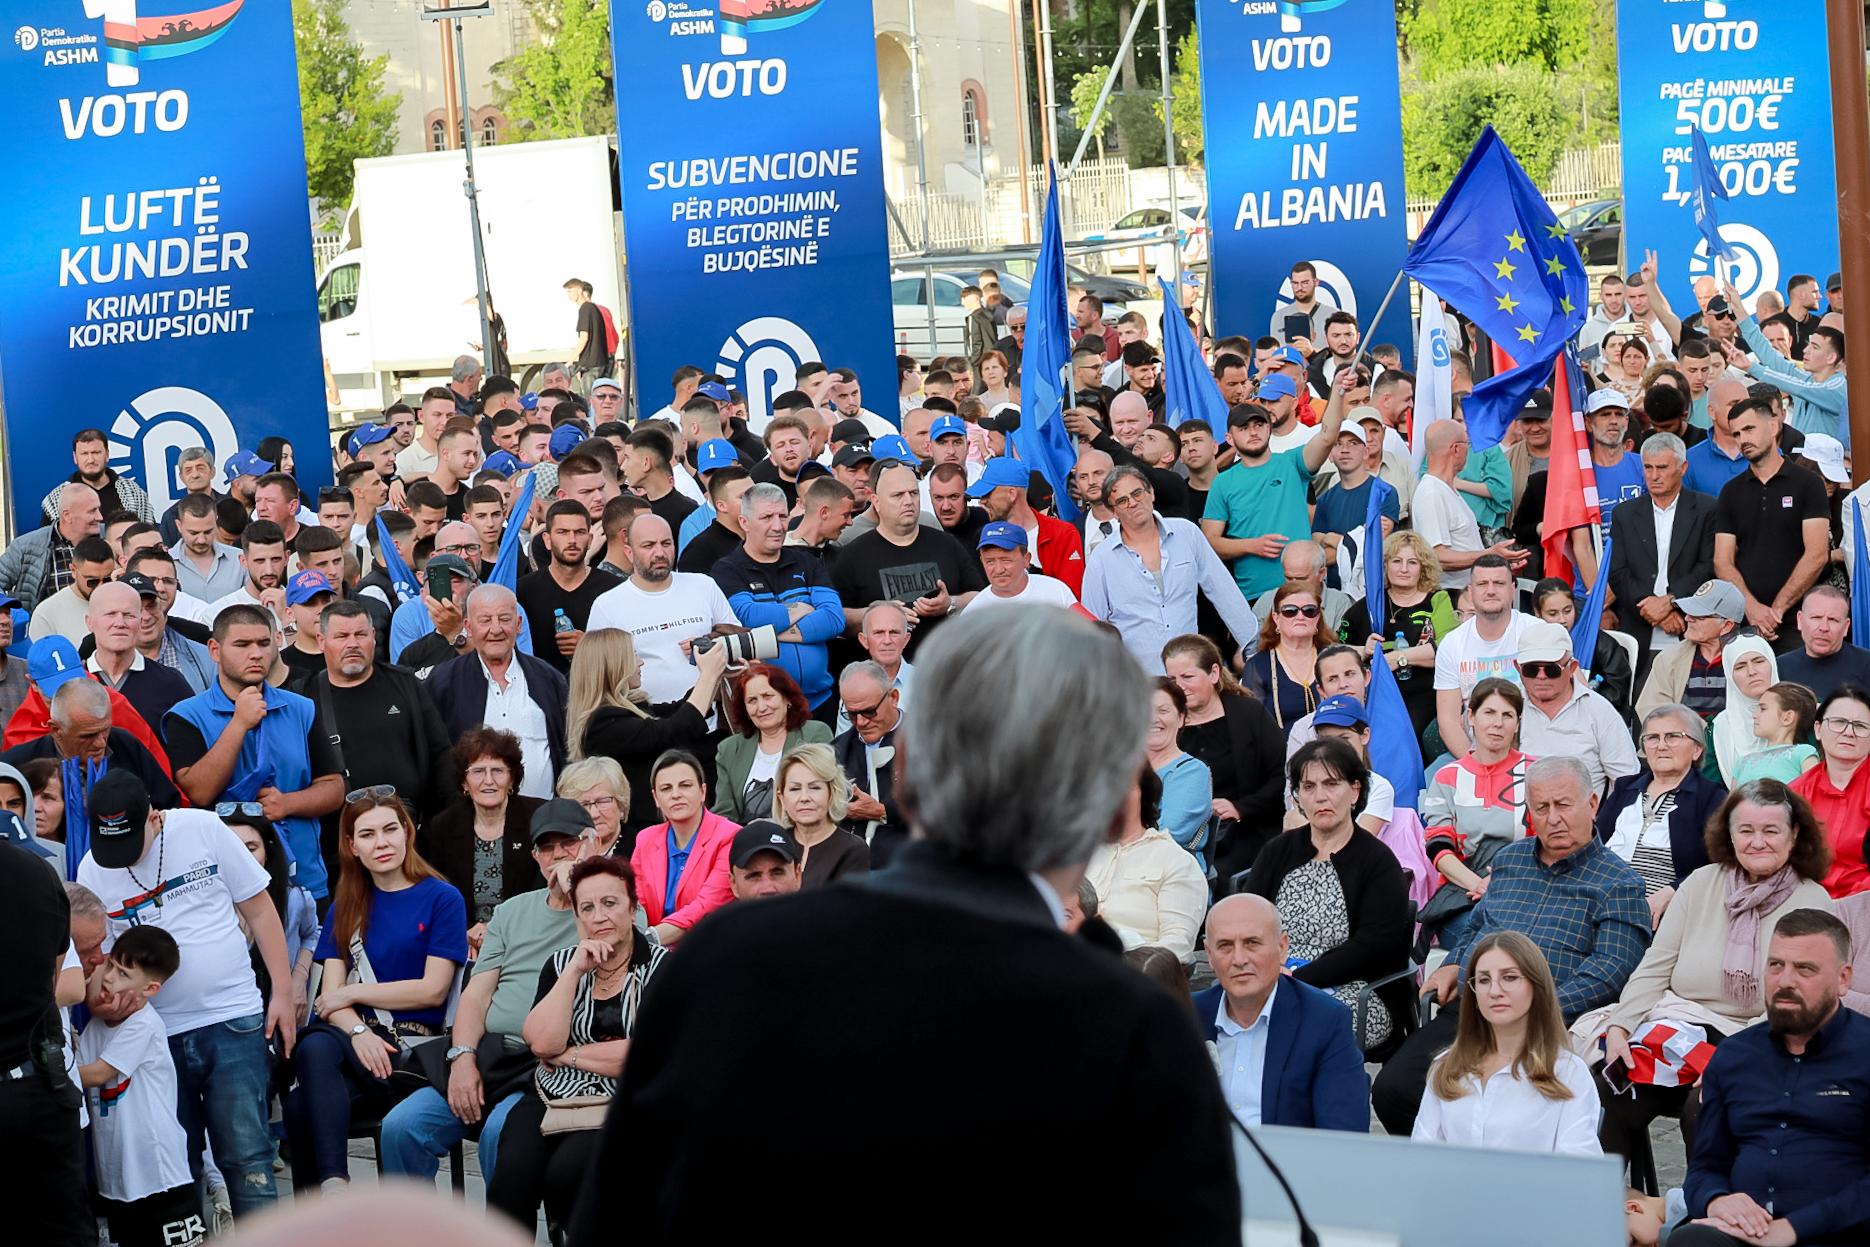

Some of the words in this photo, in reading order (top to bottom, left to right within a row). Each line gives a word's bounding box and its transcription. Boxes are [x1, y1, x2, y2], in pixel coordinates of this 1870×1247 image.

[668, 3, 688, 11] Partia
[669, 9, 714, 19] Demokratike
[1243, 2, 1277, 15] ASHM
[41, 28, 65, 37] Partia
[42, 35, 97, 46] Demokratike
[670, 20, 715, 36] ASHM
[1671, 20, 1759, 54] VOTO
[44, 47, 98, 66] ASHM
[1251, 35, 1331, 72] VOTO
[681, 58, 787, 100] VOTO
[1659, 78, 1704, 99] PAGË
[1706, 76, 1795, 98] MINIMALE
[59, 89, 189, 140] VOTO
[1253, 95, 1359, 139] MADE
[1674, 94, 1783, 136] 500€
[1291, 141, 1327, 181] IN
[1709, 141, 1797, 162] MESATARE
[647, 148, 859, 190] SUBVENCIONE
[1661, 158, 1799, 208] 1,00€
[79, 176, 221, 235] LUFTË
[671, 197, 712, 222] PËR
[716, 190, 840, 219] PRODHIMIN,
[1234, 181, 1387, 231] ALBANIA
[686, 215, 815, 248] BLEGTORINË
[817, 217, 830, 237] E
[59, 225, 249, 288] KUNDËR
[703, 242, 819, 274] BUJQËSINË
[85, 290, 175, 321] KRIMIT
[177, 285, 231, 311] DHE
[69, 308, 254, 349] KORRUPSIONIT
[943, 415, 951, 426] 1
[708, 444, 716, 459] 1
[897, 441, 907, 456] 1
[885, 567, 938, 599] EVERLAST
[631, 625, 659, 636] TOMMY
[669, 616, 704, 628] HILFIGER
[52, 651, 65, 671] 1
[1460, 660, 1489, 673] MIAMI
[11, 815, 27, 840] 1
[183, 868, 211, 883] PARID
[189, 860, 208, 870] VOTO
[166, 878, 214, 901] MAHMUTAJ
